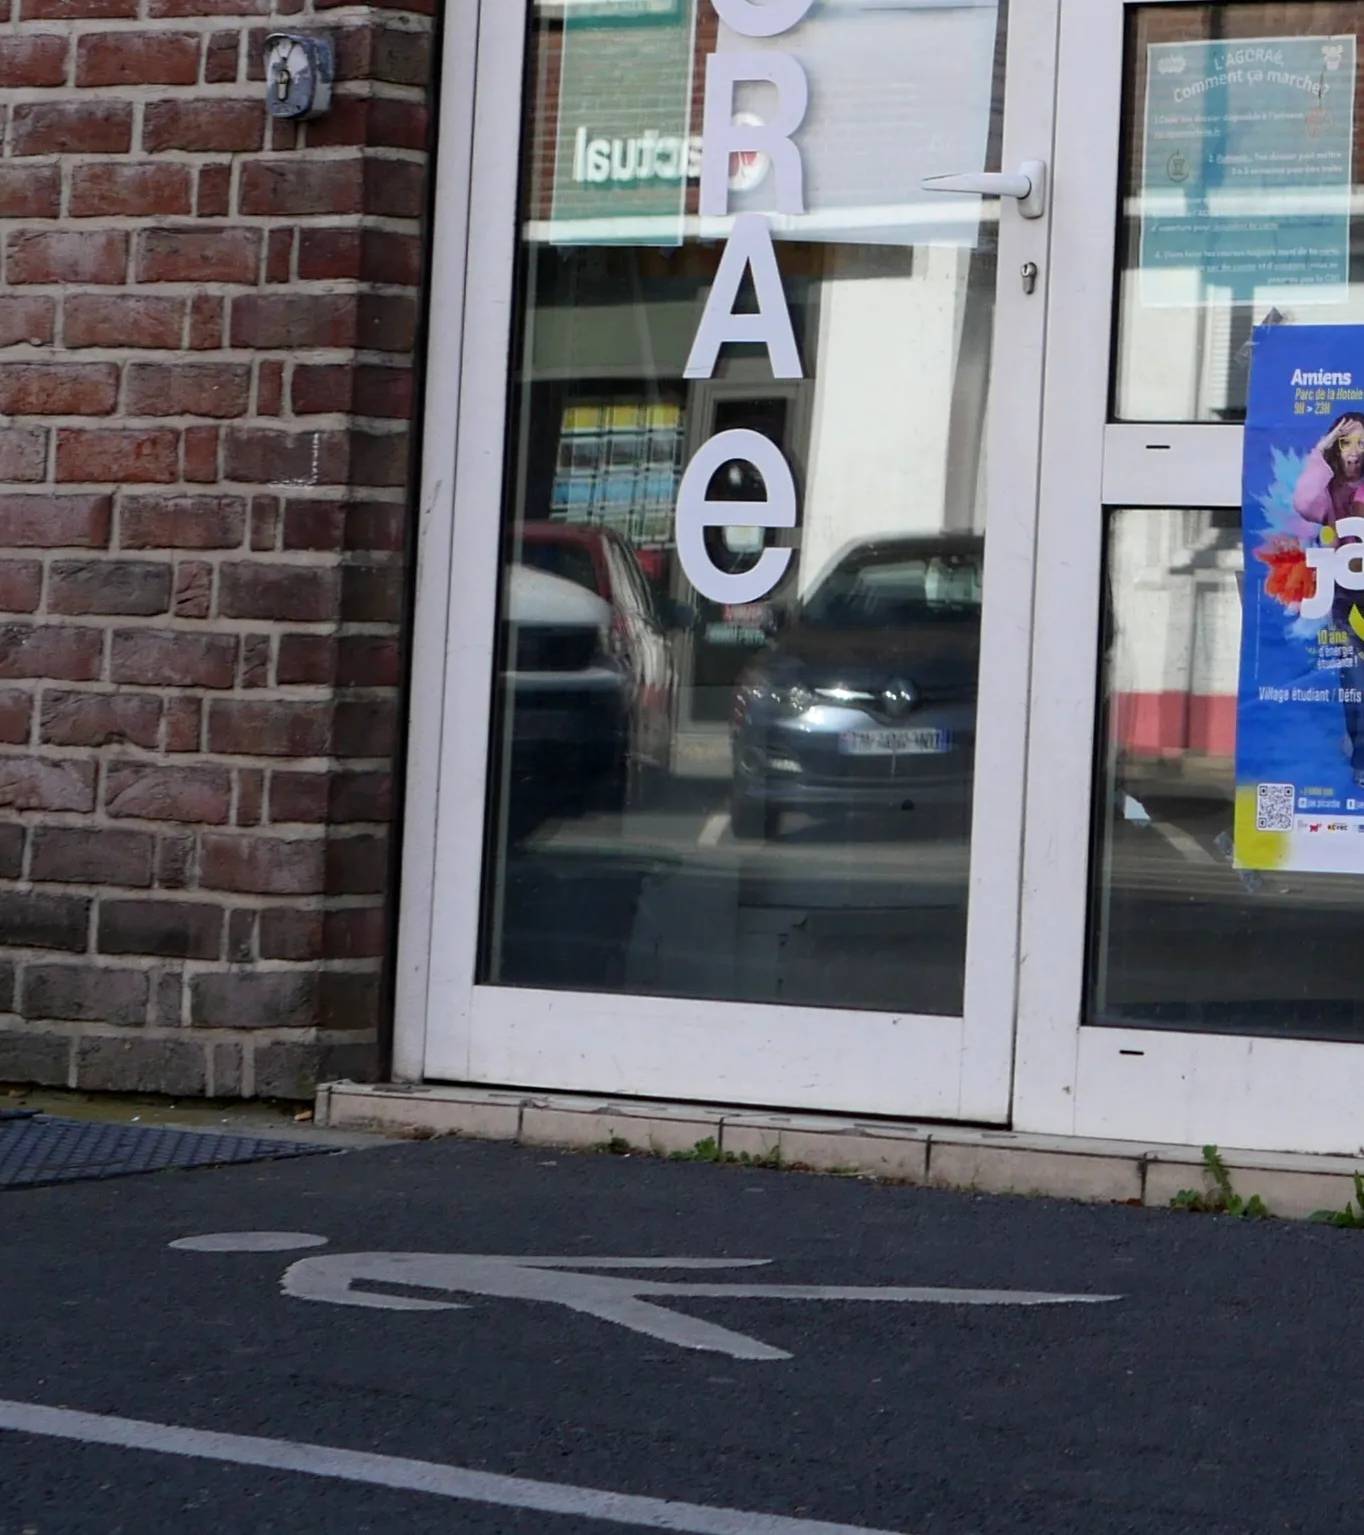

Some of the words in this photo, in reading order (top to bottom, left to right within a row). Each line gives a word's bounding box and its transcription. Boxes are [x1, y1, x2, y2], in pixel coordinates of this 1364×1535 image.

[1173, 69, 1244, 103] Comment
[1246, 69, 1264, 86] ça
[1291, 368, 1352, 386] Amiens
[1294, 388, 1313, 401] Parc
[1315, 389, 1325, 400] de
[1326, 389, 1335, 400] la
[1294, 402, 1305, 414] 9H
[1314, 402, 1331, 414] 23H
[1317, 630, 1328, 645] 10
[1329, 631, 1348, 644] ans
[1259, 686, 1290, 704] Village
[1291, 686, 1330, 702] étudiant
[1338, 686, 1362, 703] Défis
